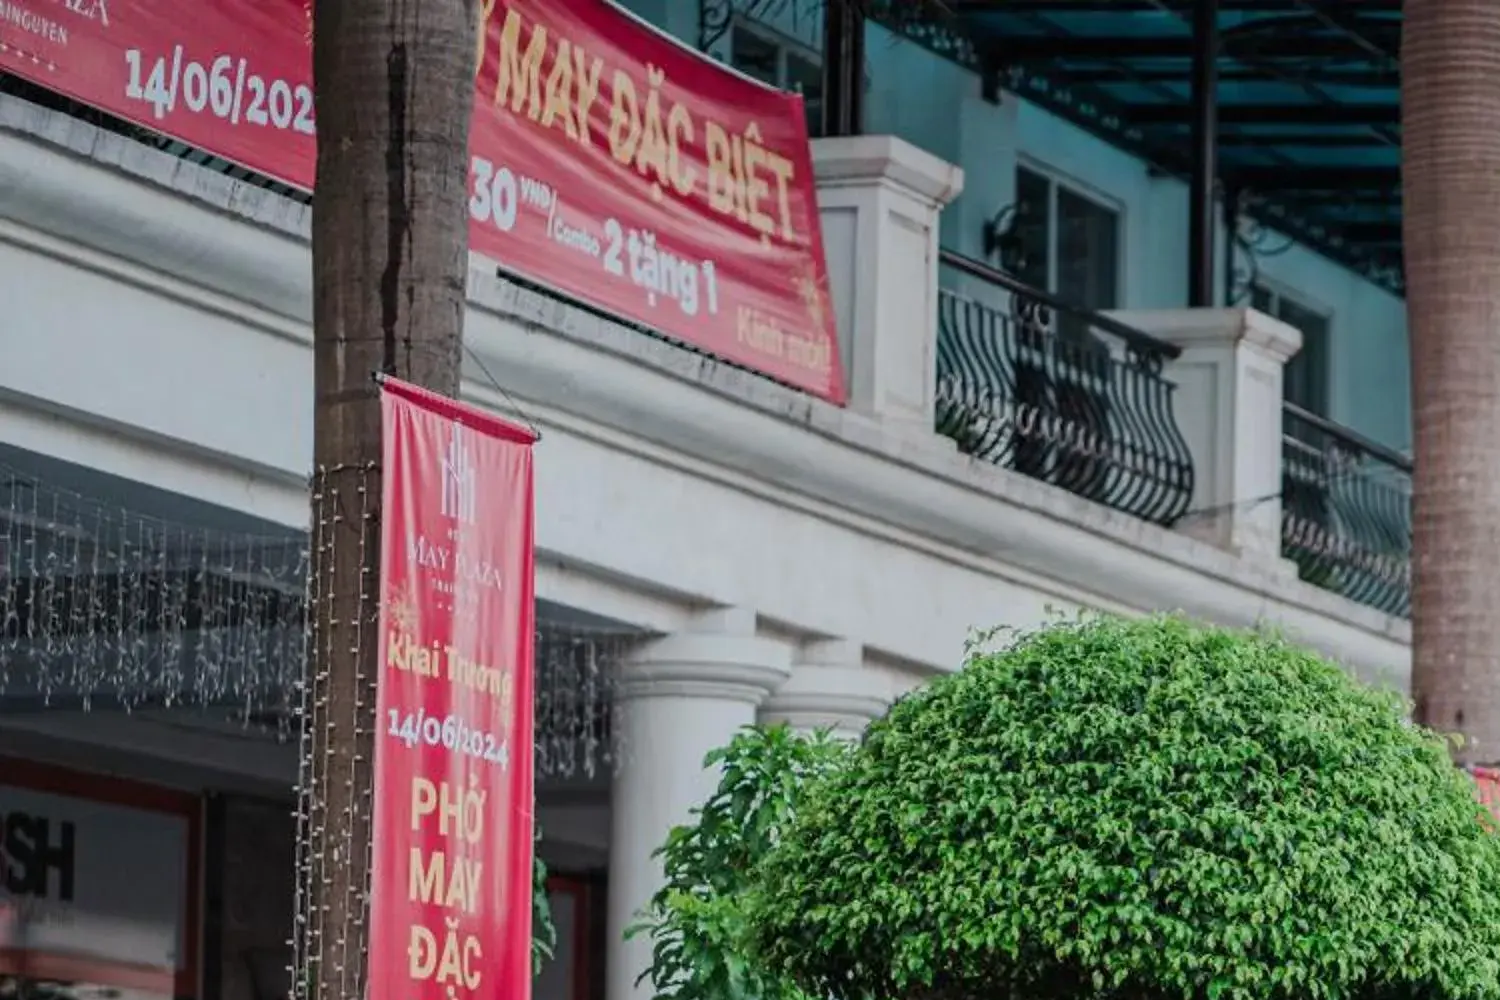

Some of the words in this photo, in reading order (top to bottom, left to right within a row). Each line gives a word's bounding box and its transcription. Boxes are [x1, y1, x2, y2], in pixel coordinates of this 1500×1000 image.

[125, 45, 316, 135] 14/06/202
[496, 9, 603, 145] MAY
[608, 63, 700, 200] ĐẶC
[706, 120, 795, 251] BIỆT
[469, 156, 517, 232] 30
[604, 217, 624, 276] 2
[628, 228, 699, 317] tặng
[701, 259, 719, 315] 1
[387, 629, 440, 679] Khai
[387, 706, 510, 770] 14/06/2024
[411, 772, 487, 844] PHỞ
[0, 811, 76, 904] SH
[408, 847, 483, 914] MAY
[408, 916, 483, 998] ĐẶC
